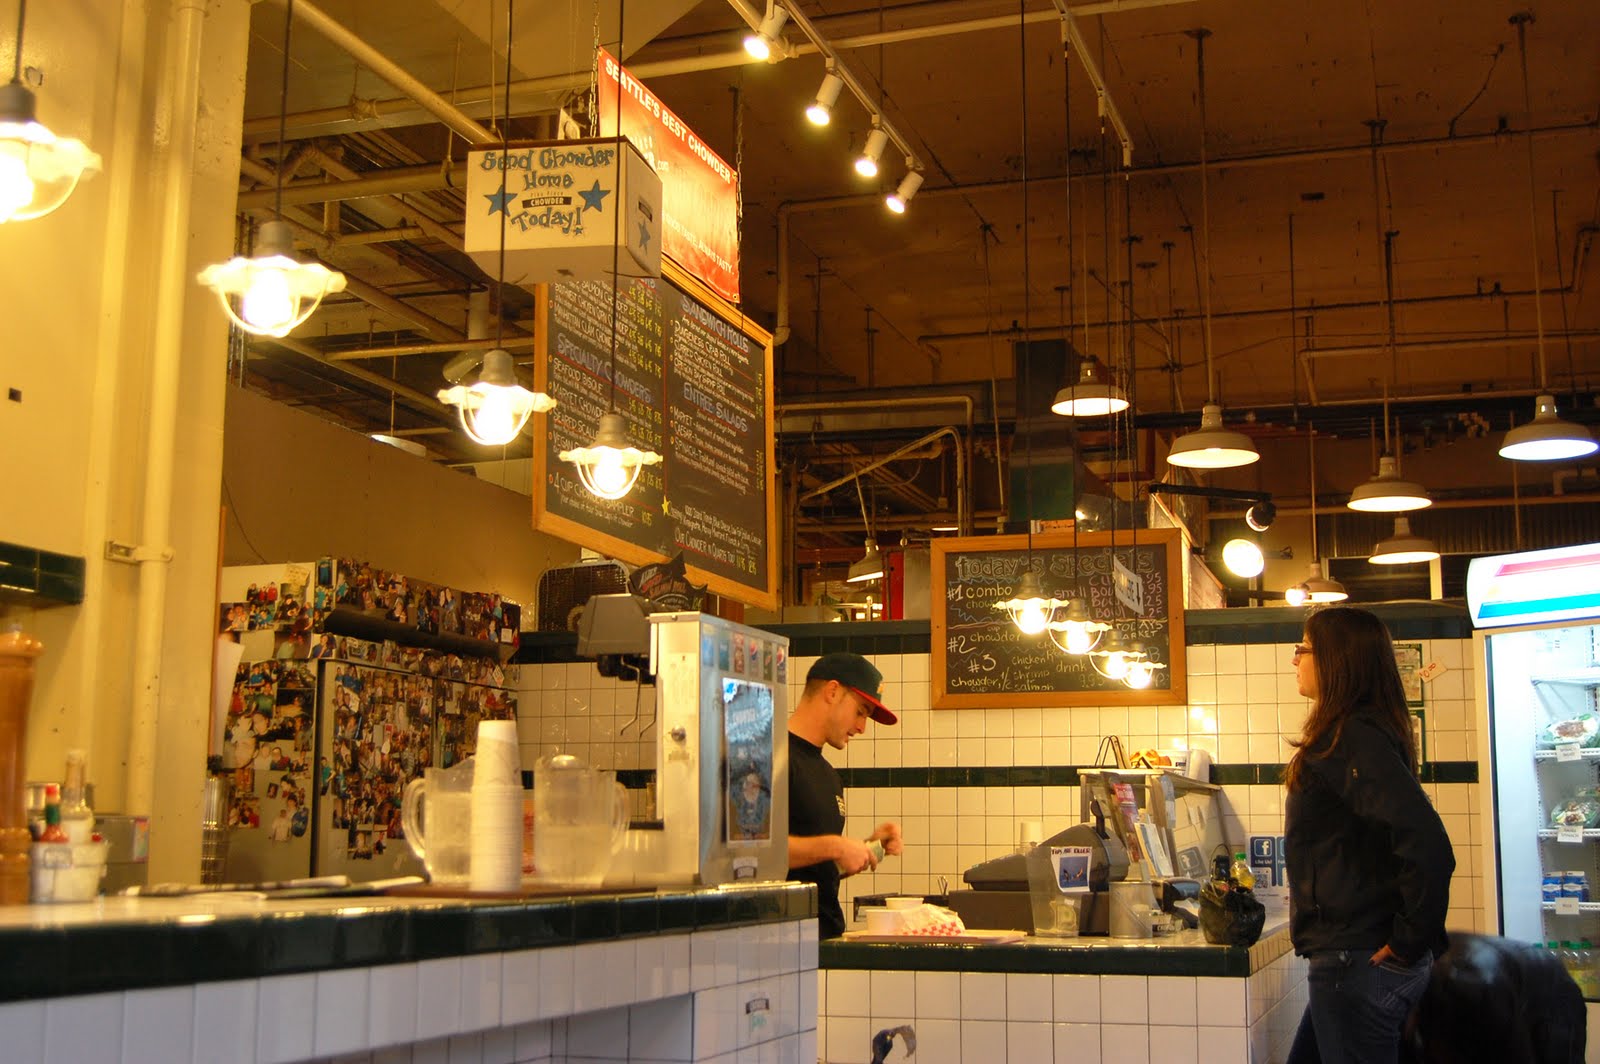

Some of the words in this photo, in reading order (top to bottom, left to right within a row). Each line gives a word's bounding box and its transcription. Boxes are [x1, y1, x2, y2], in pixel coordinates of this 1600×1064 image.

[605, 58, 660, 119] SEATTLE'S
[662, 109, 686, 141] BEST
[688, 136, 732, 185] CHOWDER
[481, 150, 534, 171] Send
[540, 147, 615, 169] Chowder
[523, 171, 574, 191] Home
[530, 197, 564, 206] CHOWDER
[510, 207, 582, 234] Today!
[557, 333, 602, 375] SPECIALTY
[553, 356, 581, 382] SEAFOOD
[552, 381, 577, 406] MARKET
[684, 382, 715, 411] ENTREE
[715, 402, 747, 430] SALADS
[560, 476, 573, 494] CUP
[947, 584, 964, 601] #1
[966, 583, 1012, 598] combo
[947, 635, 976, 654] #2
[970, 630, 1020, 642] chowder
[1121, 630, 1159, 640] ARKET
[968, 654, 997, 673] #3
[1012, 655, 1046, 666] chicken
[1056, 659, 1087, 673] drink
[1014, 680, 1054, 692] salmon
